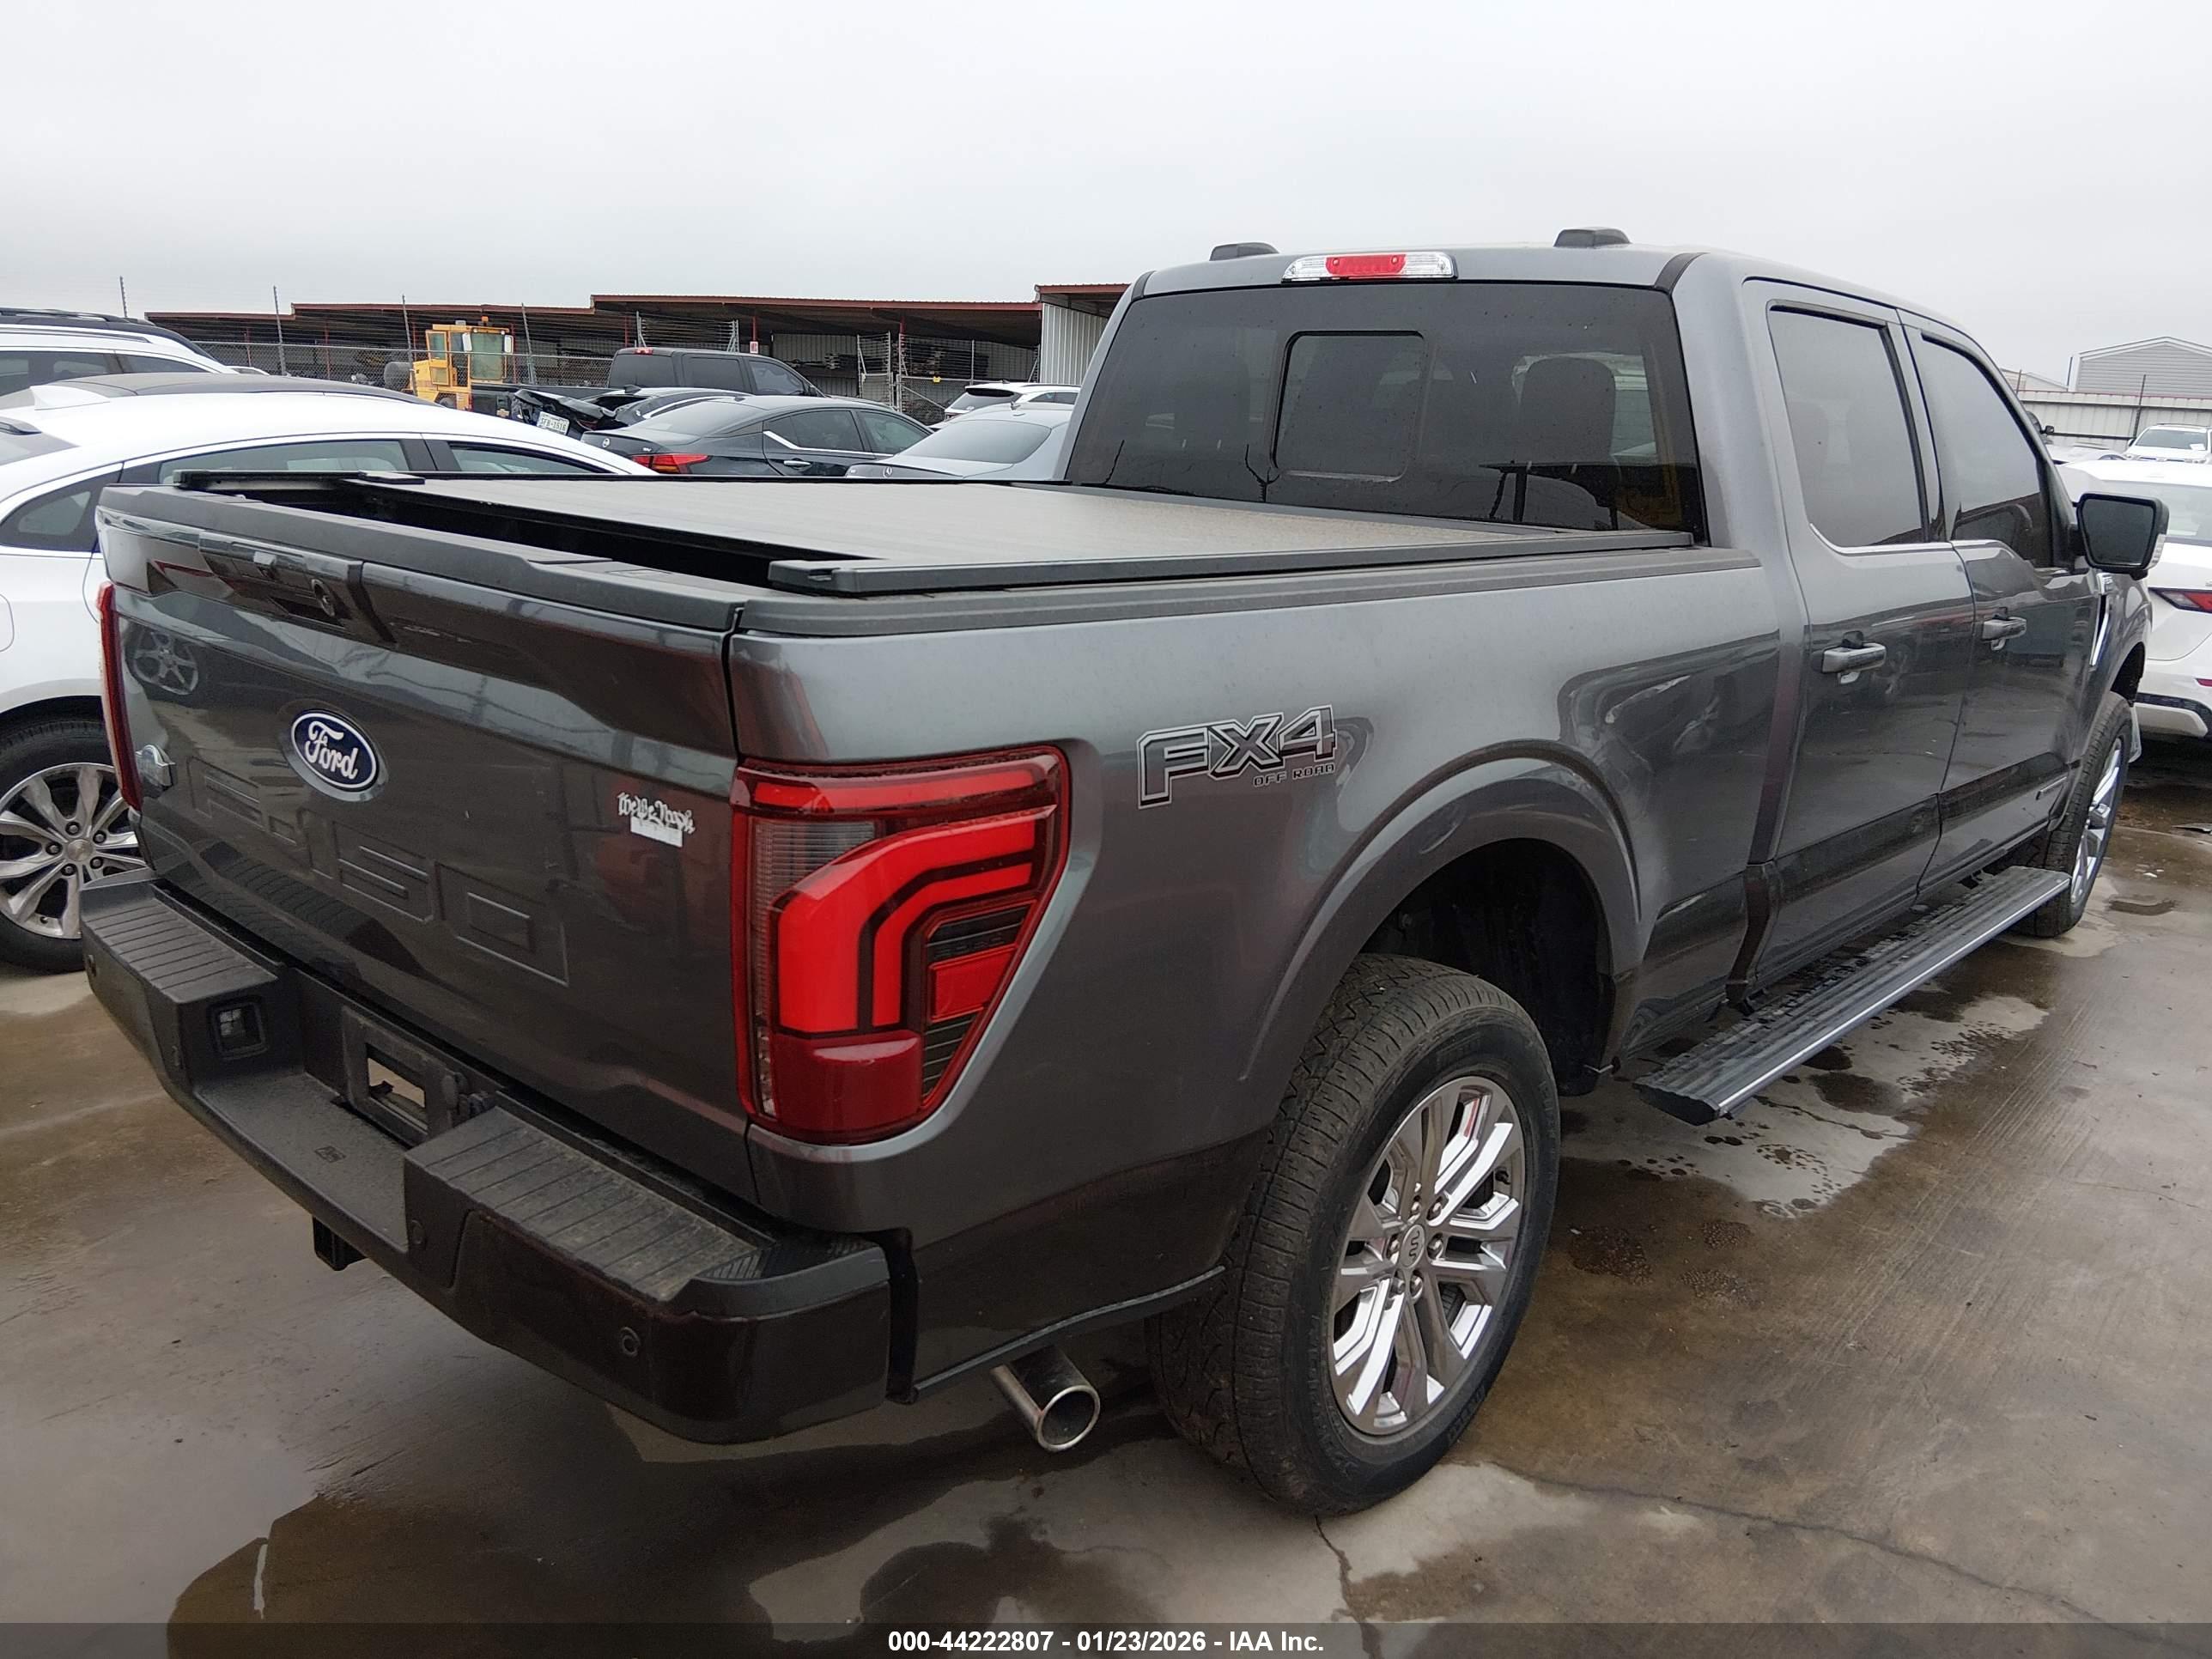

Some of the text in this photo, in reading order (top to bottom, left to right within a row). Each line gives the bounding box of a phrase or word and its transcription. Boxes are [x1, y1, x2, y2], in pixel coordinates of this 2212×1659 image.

[305, 720, 359, 780] Ford
[1137, 704, 1337, 809] FX4
[1254, 762, 1335, 787] OFF ROAD
